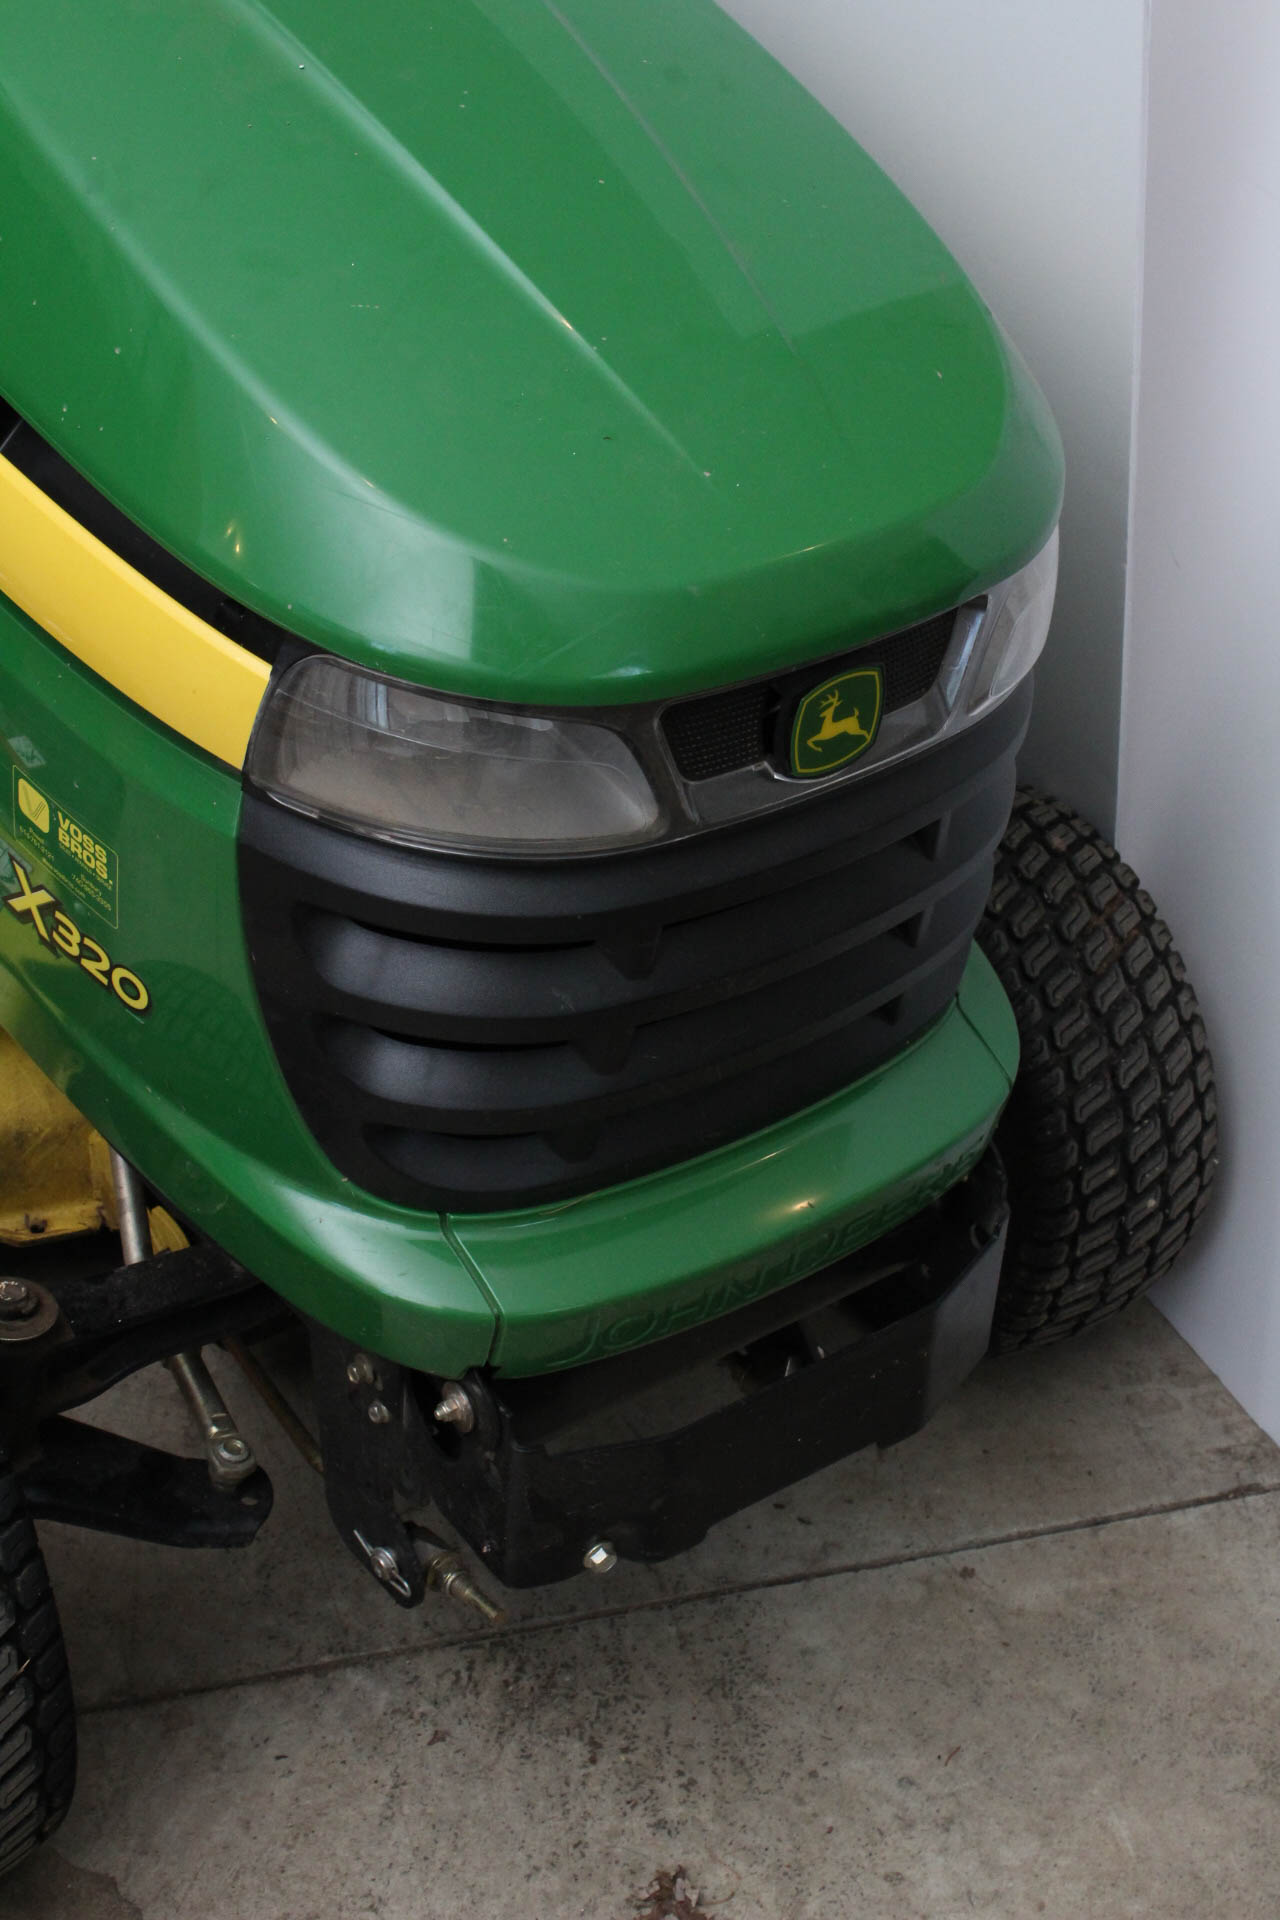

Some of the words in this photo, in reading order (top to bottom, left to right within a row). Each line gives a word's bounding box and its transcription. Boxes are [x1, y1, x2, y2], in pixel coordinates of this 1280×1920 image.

[58, 811, 107, 864] VOSS
[58, 827, 113, 885] BROS.
[6, 854, 149, 1010] X320
[546, 1264, 769, 1368] JOHN
